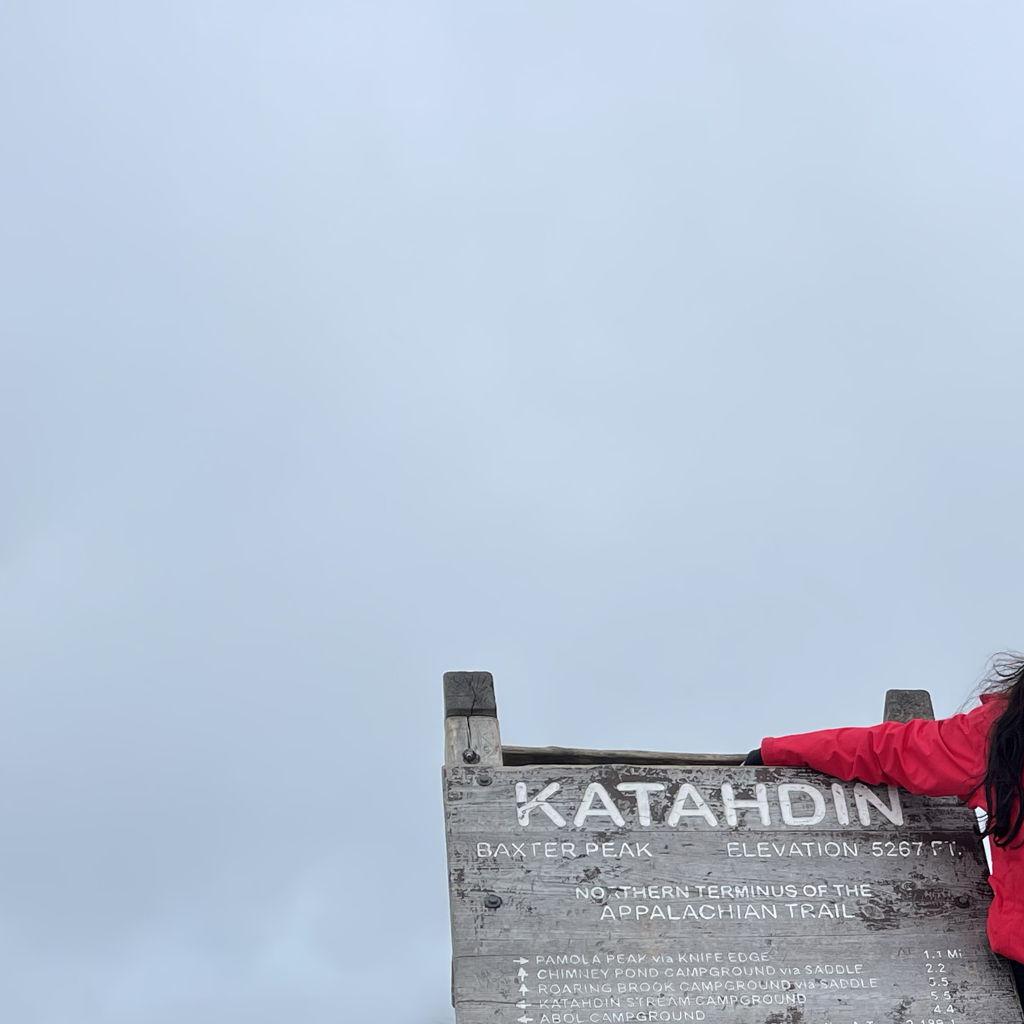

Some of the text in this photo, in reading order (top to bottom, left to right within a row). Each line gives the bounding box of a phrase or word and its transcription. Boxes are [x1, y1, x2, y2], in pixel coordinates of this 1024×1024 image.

[515, 781, 904, 827] KATAHDIN
[476, 842, 577, 858] BAXTER
[585, 842, 653, 858] PEAK
[727, 841, 858, 858] ELEVATION
[872, 841, 922, 857] 5267
[697, 884, 798, 898] TERMINUS
[803, 884, 828, 898] OF
[833, 884, 873, 897] THE
[600, 903, 855, 920] APPALACHIAN TRAIL
[536, 954, 601, 965] PAMOLA
[652, 953, 674, 963] via
[678, 952, 723, 963] KNIFE
[728, 952, 771, 963] EDGE
[923, 950, 942, 959] 1.1
[537, 963, 946, 980] CHIMNEY POND CAMPGROUND via SADDLE 2.2
[538, 983, 613, 994] ROARING
[617, 982, 676, 993] BROOK
[679, 980, 791, 992] CAMPGROUND
[794, 979, 815, 990] via
[820, 978, 879, 989] SADDLE
[540, 997, 621, 1009] KATAHDIN
[627, 996, 691, 1008] STREAM
[696, 994, 807, 1006] CAMPGROUND
[540, 1013, 585, 1024] ABOL
[590, 1011, 706, 1023] CAMPGROUND
